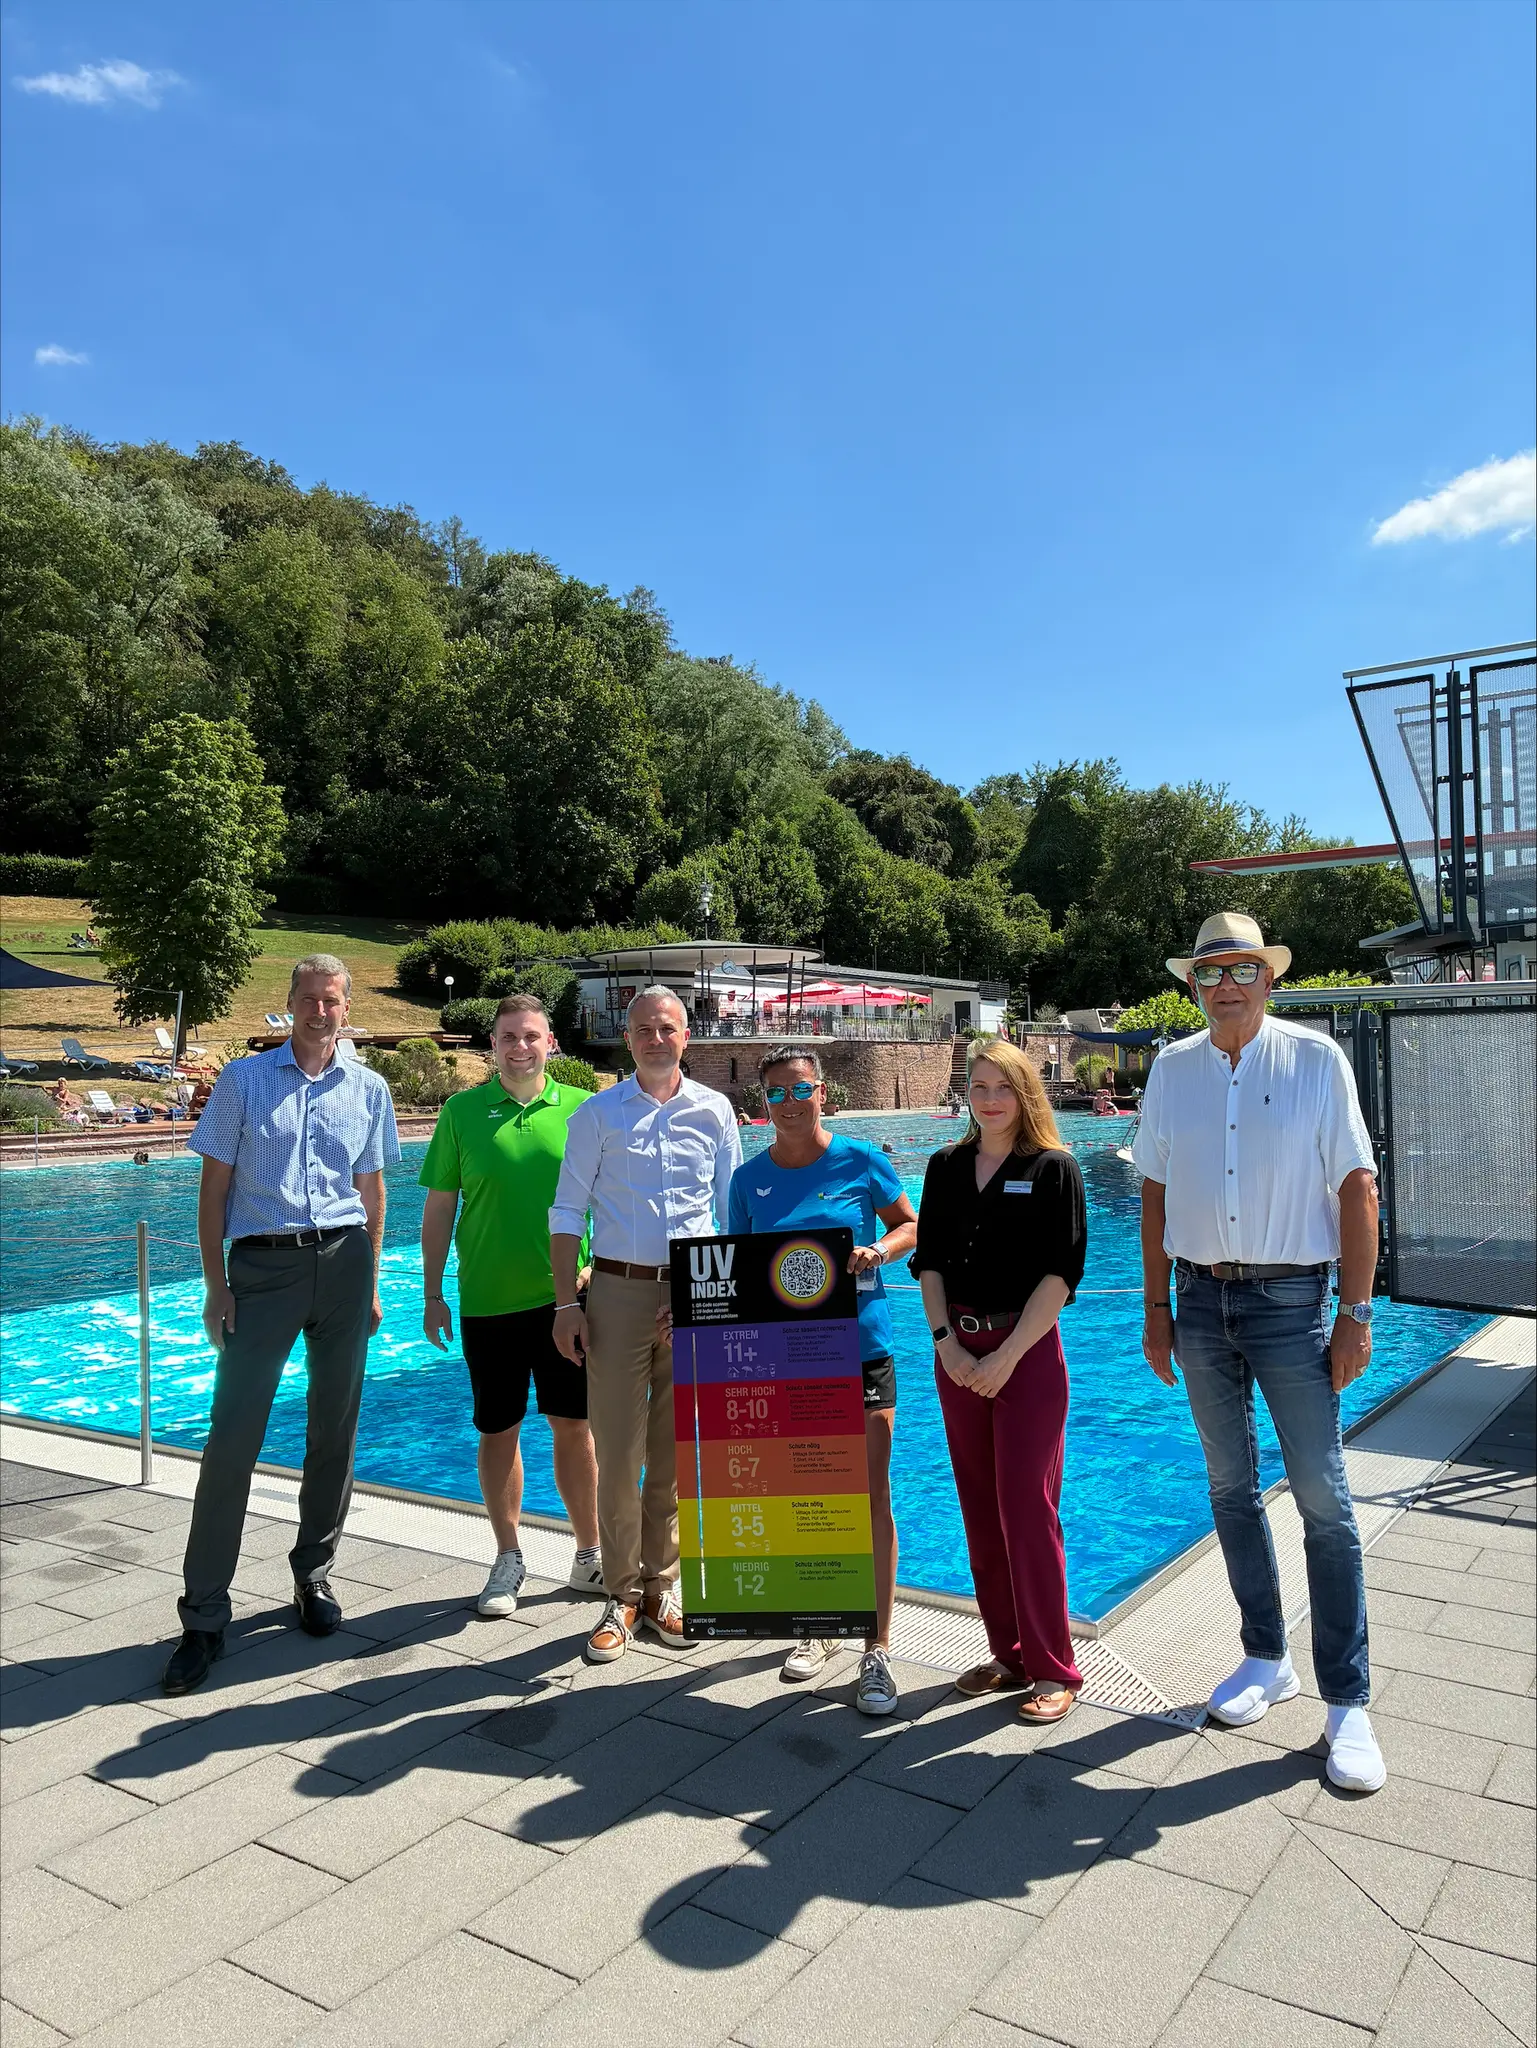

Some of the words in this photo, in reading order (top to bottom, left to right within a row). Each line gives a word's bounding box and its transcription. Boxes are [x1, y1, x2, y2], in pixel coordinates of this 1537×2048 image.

[690, 1244, 735, 1281] UV
[691, 1280, 737, 1299] INDEX
[723, 1329, 758, 1340] EXTREM
[724, 1342, 757, 1362] 11+
[725, 1387, 748, 1397] SEHR
[751, 1386, 775, 1397] HOCH
[727, 1399, 768, 1420] 8-10
[728, 1445, 752, 1455] HOCH
[728, 1457, 760, 1478] 6-7
[730, 1503, 763, 1513] MITTEL
[731, 1516, 764, 1536] 3-5
[733, 1561, 769, 1572] NIEDRIG
[828, 1560, 841, 1568] nötig
[734, 1575, 764, 1596] 1-2
